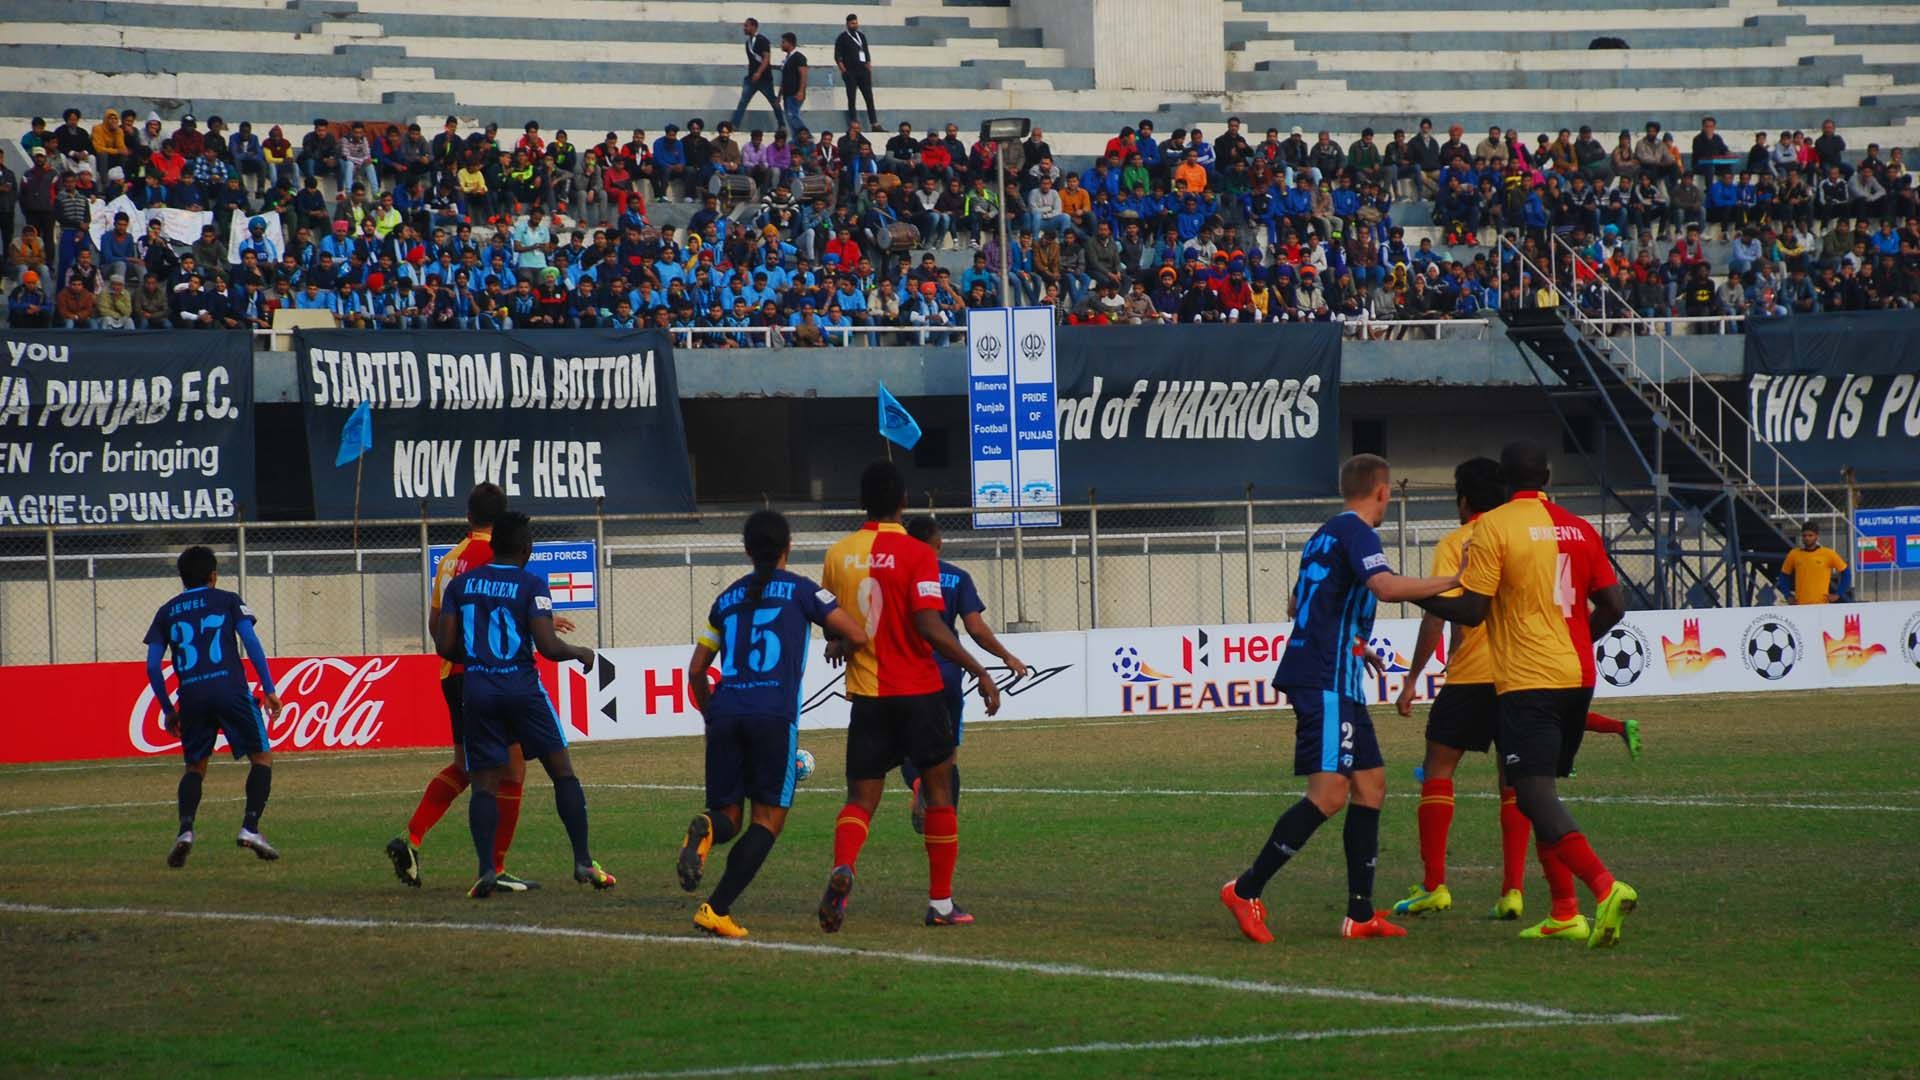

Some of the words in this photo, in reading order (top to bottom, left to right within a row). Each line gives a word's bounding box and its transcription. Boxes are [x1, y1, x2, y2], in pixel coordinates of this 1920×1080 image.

[7, 341, 69, 366] you
[310, 348, 421, 409] STARTED
[427, 352, 504, 410] FROM
[510, 354, 547, 409] DA
[551, 350, 657, 409] BOTTOM
[975, 382, 1007, 391] Minerva
[38, 375, 172, 434] PUNJAB
[178, 366, 239, 422] F.C.
[976, 403, 1005, 414] Punjab
[1022, 393, 1048, 402] PRIDE
[1100, 379, 1148, 440] of
[1145, 375, 1321, 440] WARRIORS
[1750, 373, 1827, 442] THIS
[1827, 374, 1873, 439] IS
[975, 424, 1008, 433] Football
[1029, 412, 1041, 421] OF
[982, 445, 1002, 455] Club
[1019, 430, 1053, 440] PUNJAB
[49, 442, 93, 473] for
[102, 440, 219, 477] bringing
[394, 440, 462, 497] NOW
[474, 439, 521, 496] WE
[533, 440, 606, 497] HERE
[81, 496, 107, 523] to
[109, 488, 234, 521] PUNJAB
[1858, 516, 1893, 526] SALUTING
[1895, 515, 1908, 525] THE
[528, 551, 553, 562] RMED
[554, 550, 588, 561] FORCES
[844, 552, 896, 569] PLAZA
[464, 578, 519, 599] KAREEM
[1553, 552, 1576, 618] 4
[169, 598, 207, 617] JEWEL
[857, 577, 883, 639] 9
[171, 614, 225, 671] 37
[460, 604, 522, 660] 10
[722, 607, 782, 676] 15
[1121, 679, 1294, 714] I-LEAGU
